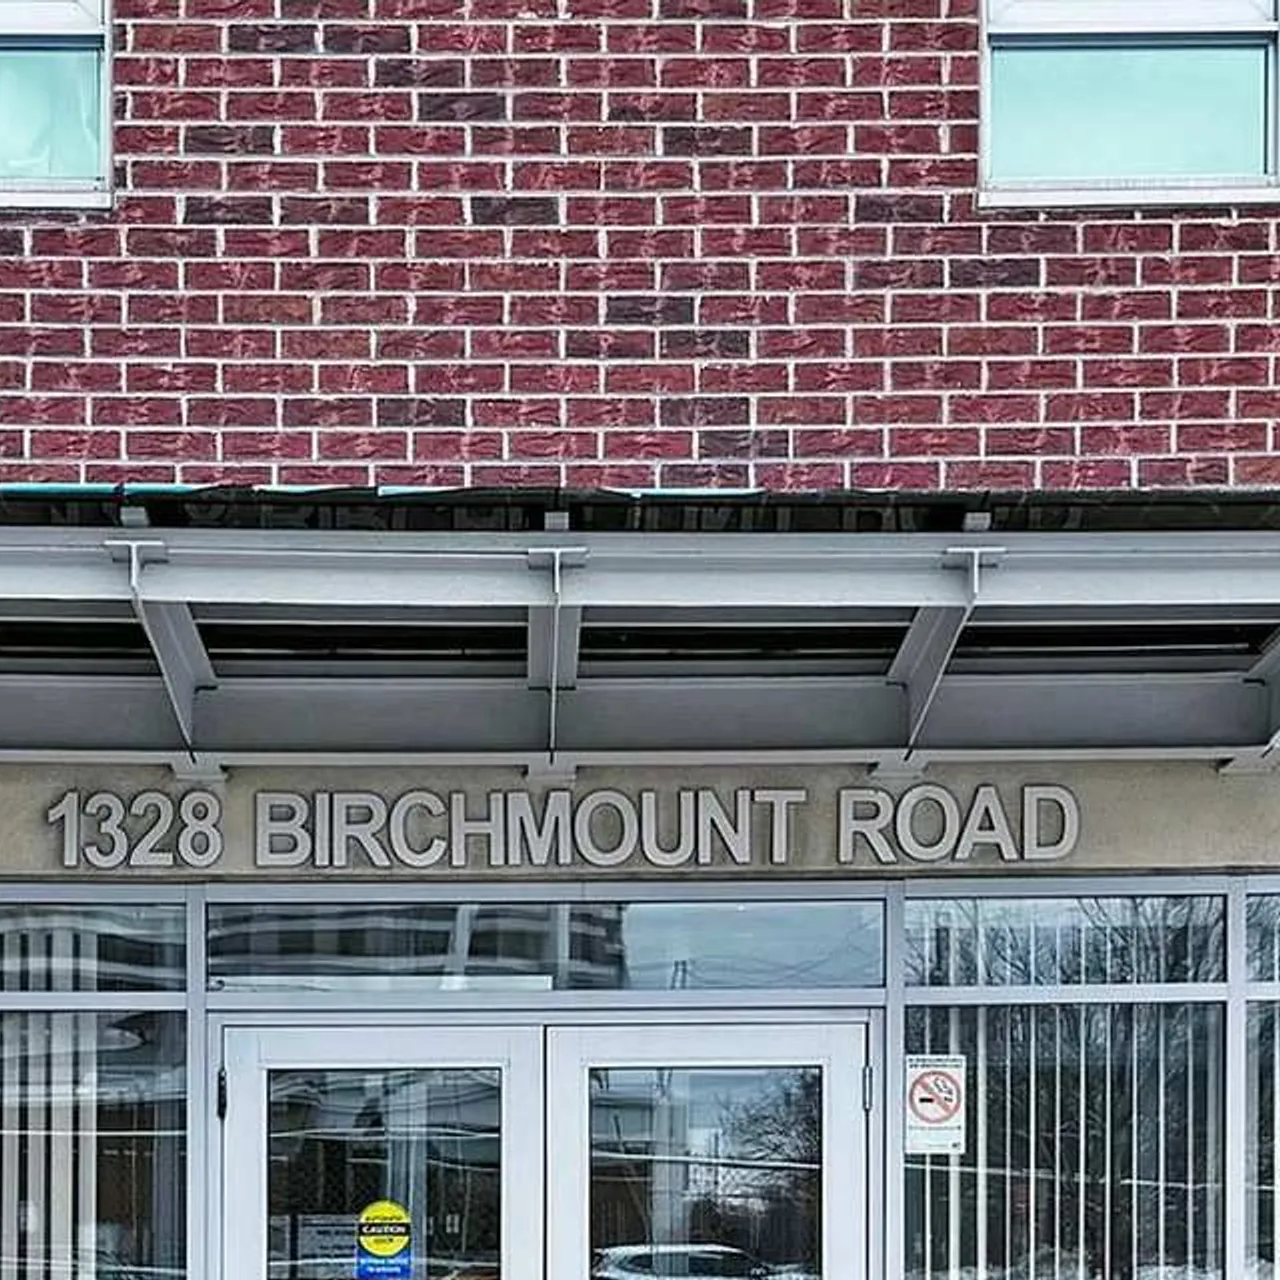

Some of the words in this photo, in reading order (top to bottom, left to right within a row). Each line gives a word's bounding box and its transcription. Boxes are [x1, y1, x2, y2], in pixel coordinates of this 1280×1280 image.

[47, 788, 223, 868] 1328
[254, 788, 808, 868] BIRCHMOUNT
[838, 784, 1080, 864] ROAD
